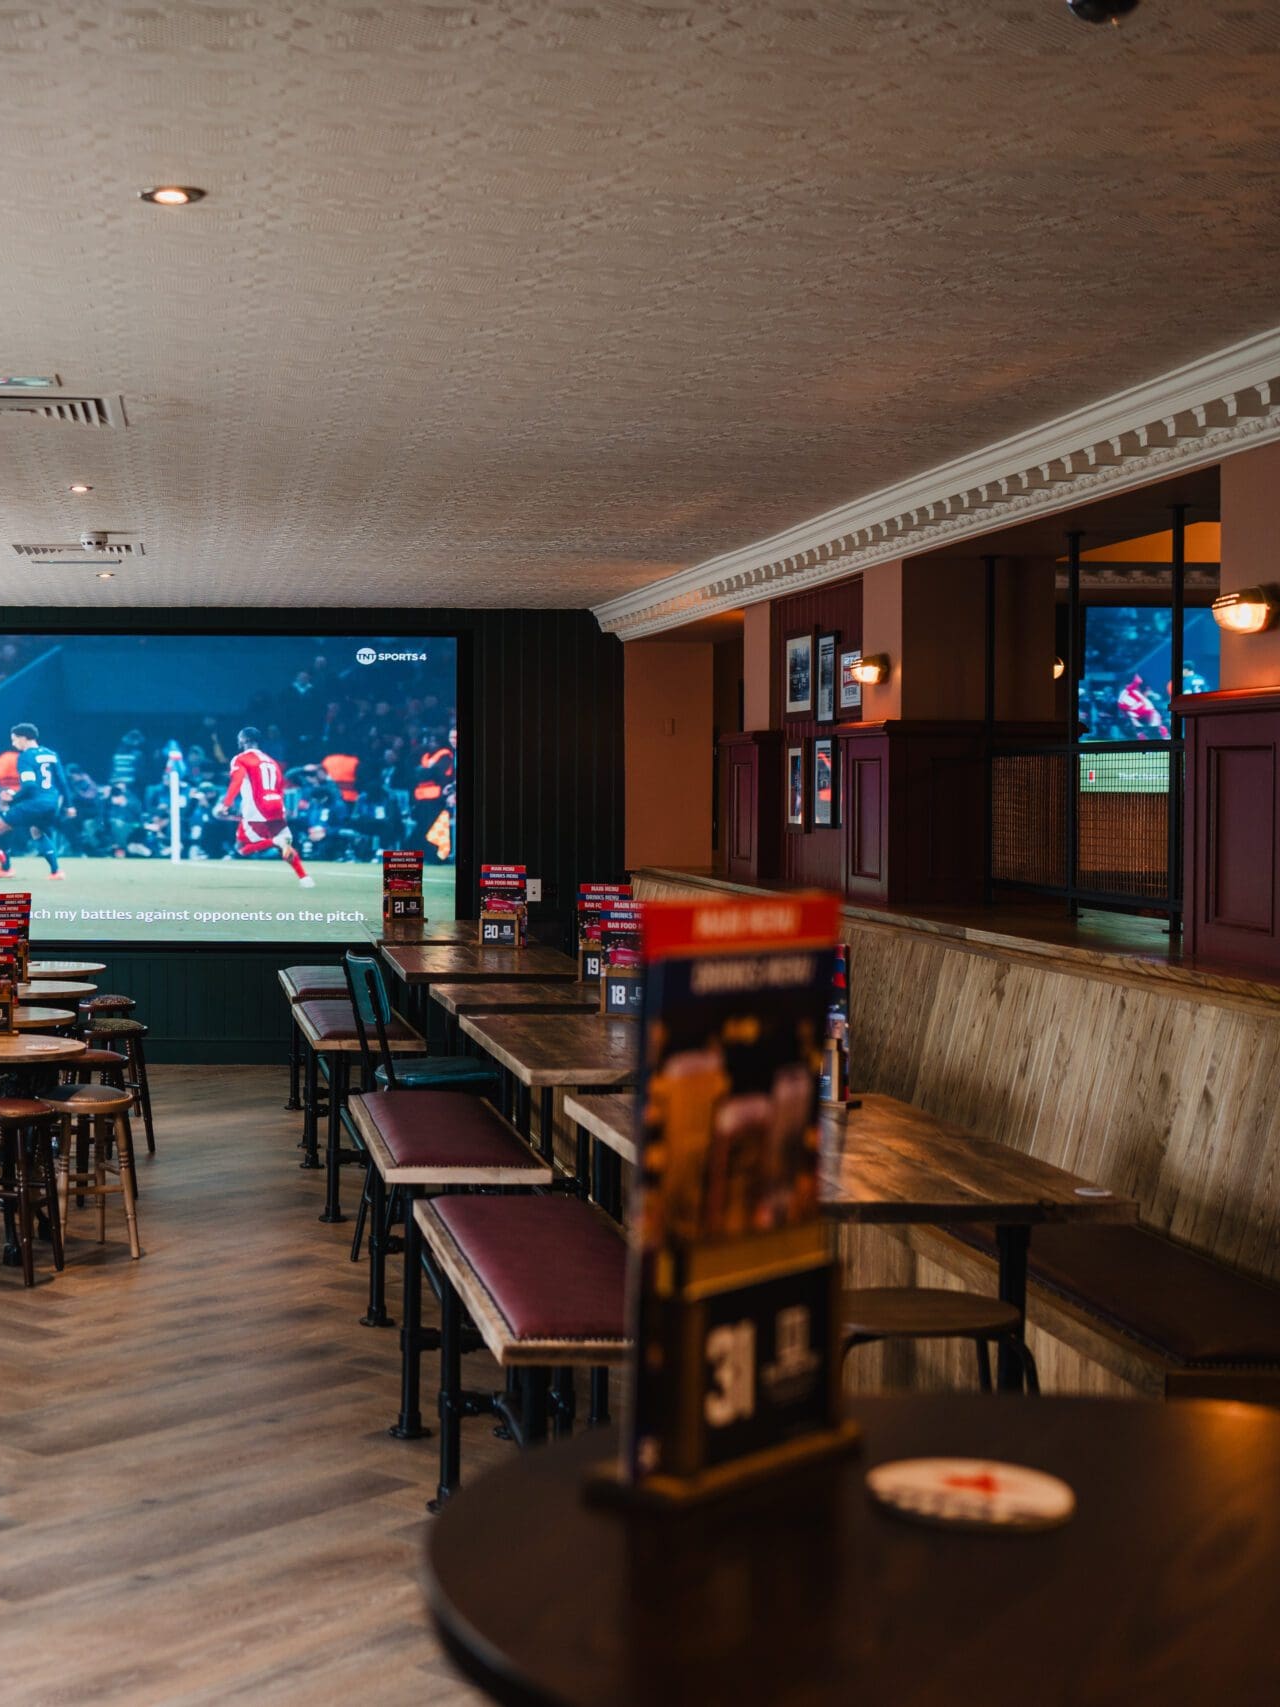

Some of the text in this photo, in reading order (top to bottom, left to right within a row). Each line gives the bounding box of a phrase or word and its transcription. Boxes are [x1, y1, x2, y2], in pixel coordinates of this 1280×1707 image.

[378, 653, 418, 661] SPORTS
[419, 653, 427, 661] 4
[394, 901, 405, 914] 21
[55, 909, 76, 922] my
[81, 909, 131, 921] battles
[135, 910, 189, 923] against
[193, 912, 273, 923] opponents
[276, 913, 295, 921] on
[298, 911, 323, 922] the
[326, 911, 369, 924] pitch.
[484, 923, 499, 939] 20
[587, 958, 599, 974] 19
[611, 985, 626, 1005] 18
